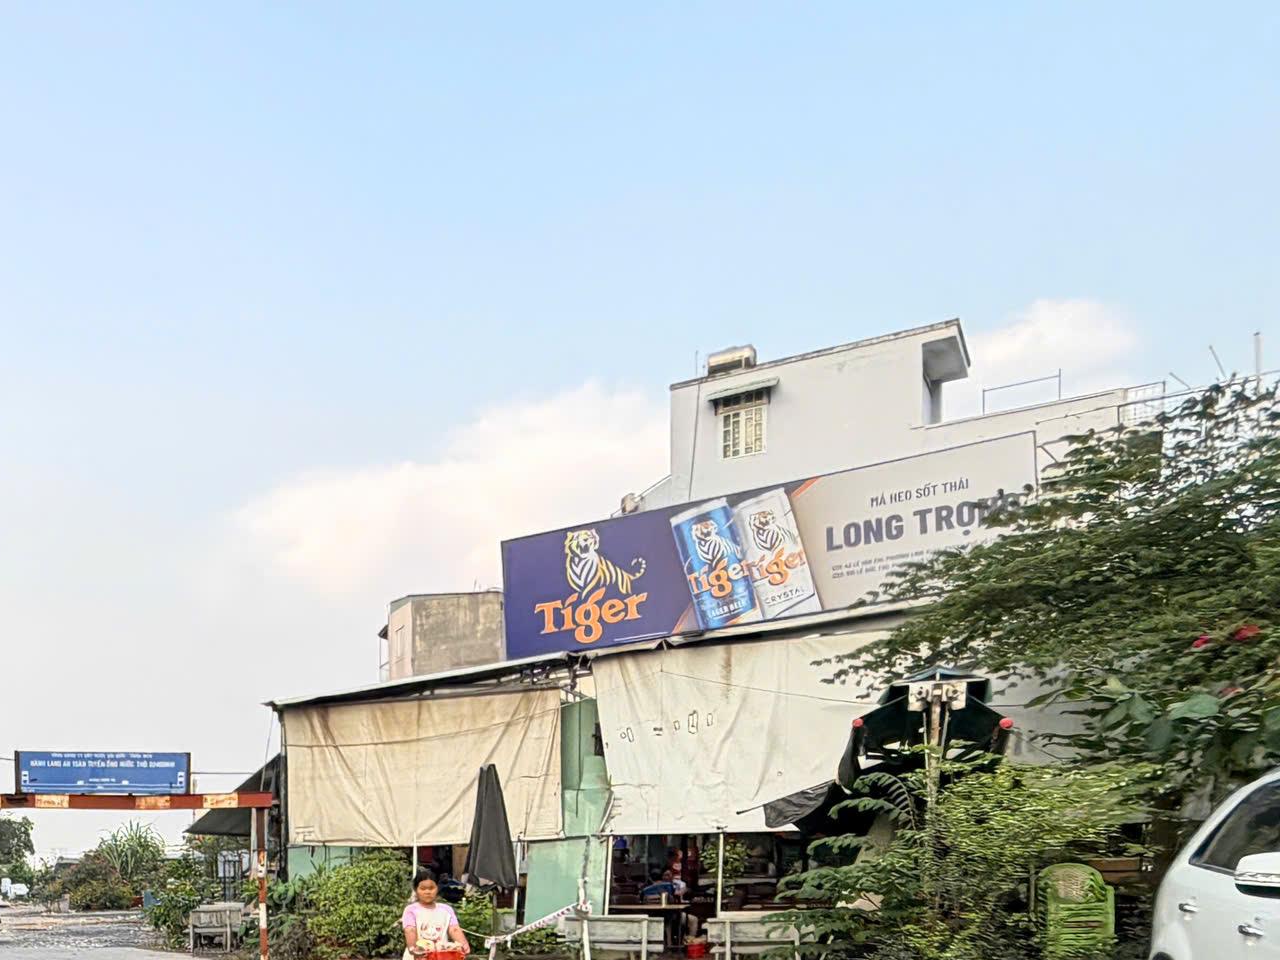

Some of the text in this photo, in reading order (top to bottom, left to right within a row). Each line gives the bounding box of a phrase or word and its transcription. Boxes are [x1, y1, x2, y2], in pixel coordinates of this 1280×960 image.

[889, 489, 912, 504] HEO
[915, 482, 938, 499] SỐT
[941, 477, 969, 495] THÁI
[825, 514, 905, 552] LONG
[534, 586, 648, 644] Tiger
